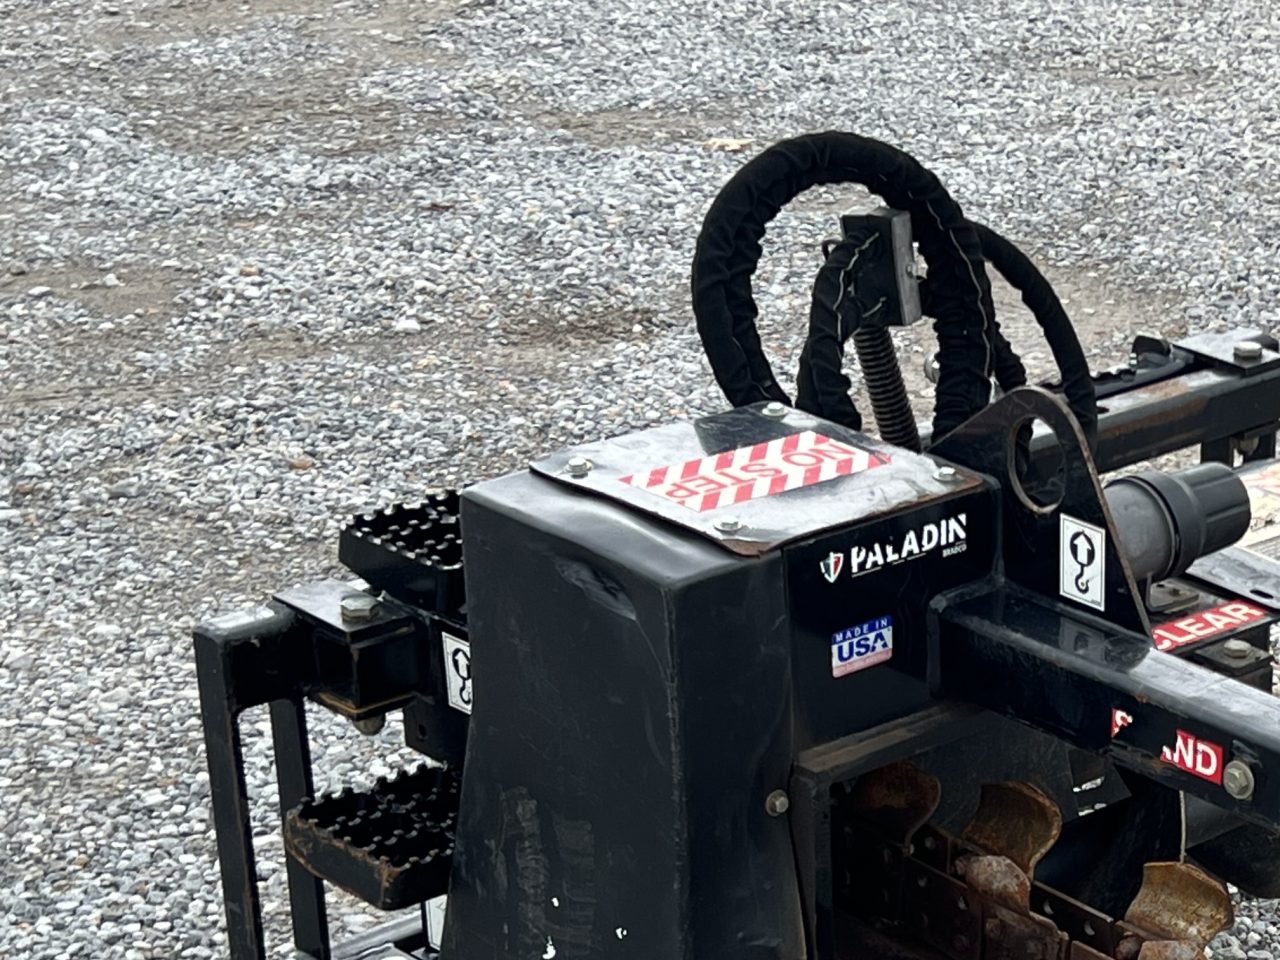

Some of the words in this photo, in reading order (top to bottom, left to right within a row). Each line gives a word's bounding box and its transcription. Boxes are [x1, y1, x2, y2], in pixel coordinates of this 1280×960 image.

[782, 443, 856, 467] NO
[665, 463, 782, 499] STEP
[851, 513, 967, 574] PALADIN
[835, 623, 870, 642] MADE
[875, 617, 889, 630] IN
[837, 632, 889, 663] USA
